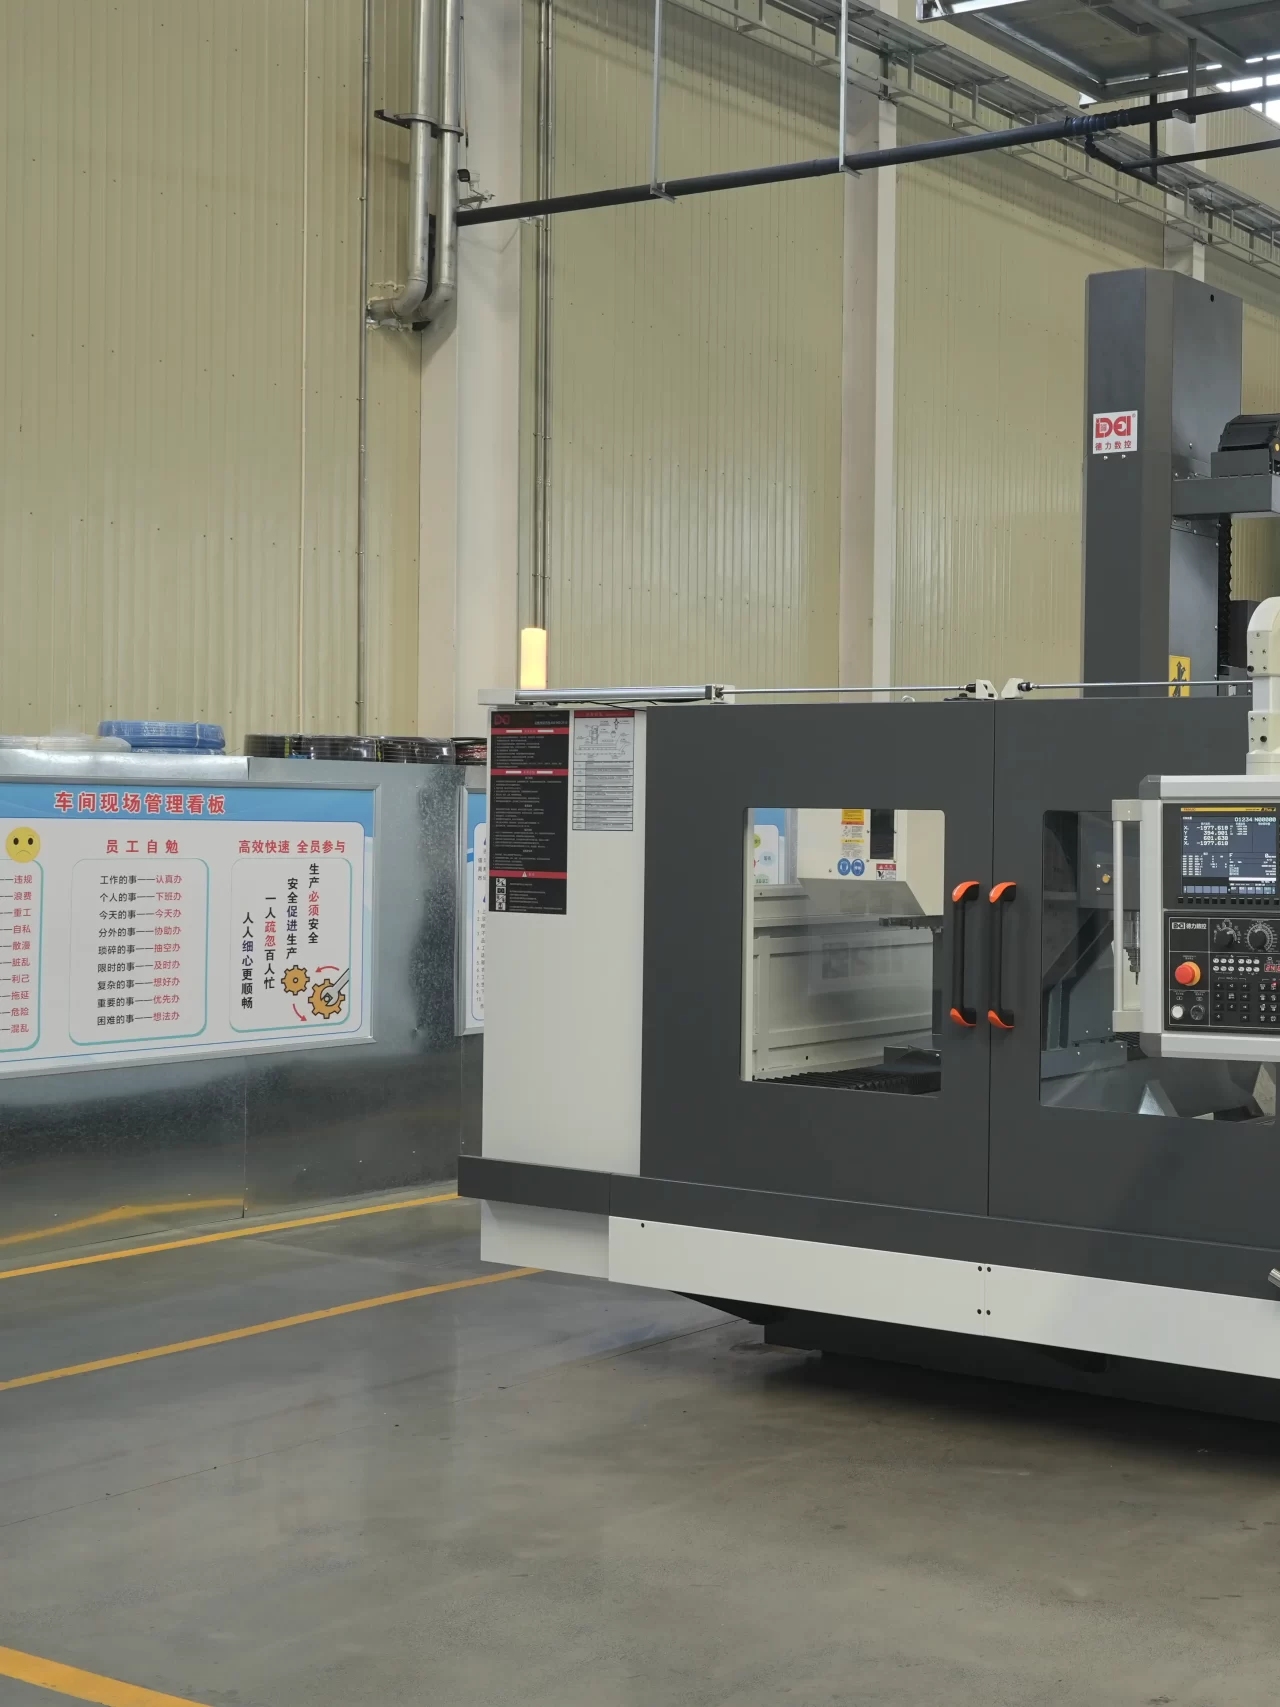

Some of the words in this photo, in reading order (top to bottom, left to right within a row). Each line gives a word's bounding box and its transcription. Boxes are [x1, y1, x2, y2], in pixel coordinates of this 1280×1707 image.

[1095, 440, 1132, 450] 德力数控
[54, 792, 226, 814] 车间现场管理看板
[106, 840, 179, 854] 员工自勉
[238, 840, 290, 854] 高效快速
[297, 840, 346, 854] 全员参与
[100, 874, 182, 885] 工作的事——认真办
[100, 892, 182, 902] 个人的事——下班办
[308, 863, 319, 944] 生产必须安全
[99, 909, 182, 919] 今天的事——今天办
[286, 878, 298, 959] 安全促进生产
[98, 926, 182, 937] 分外的事——协助办
[264, 897, 276, 989] 一人疏忽百人忙
[98, 960, 180, 972] 限时的事——及时办
[241, 912, 254, 1009] 人人细心更顺畅
[97, 978, 180, 990] 复杂的事——想好办
[97, 995, 180, 1008] 重要的事——优先办
[97, 1012, 180, 1026] 困难的事——想法办
